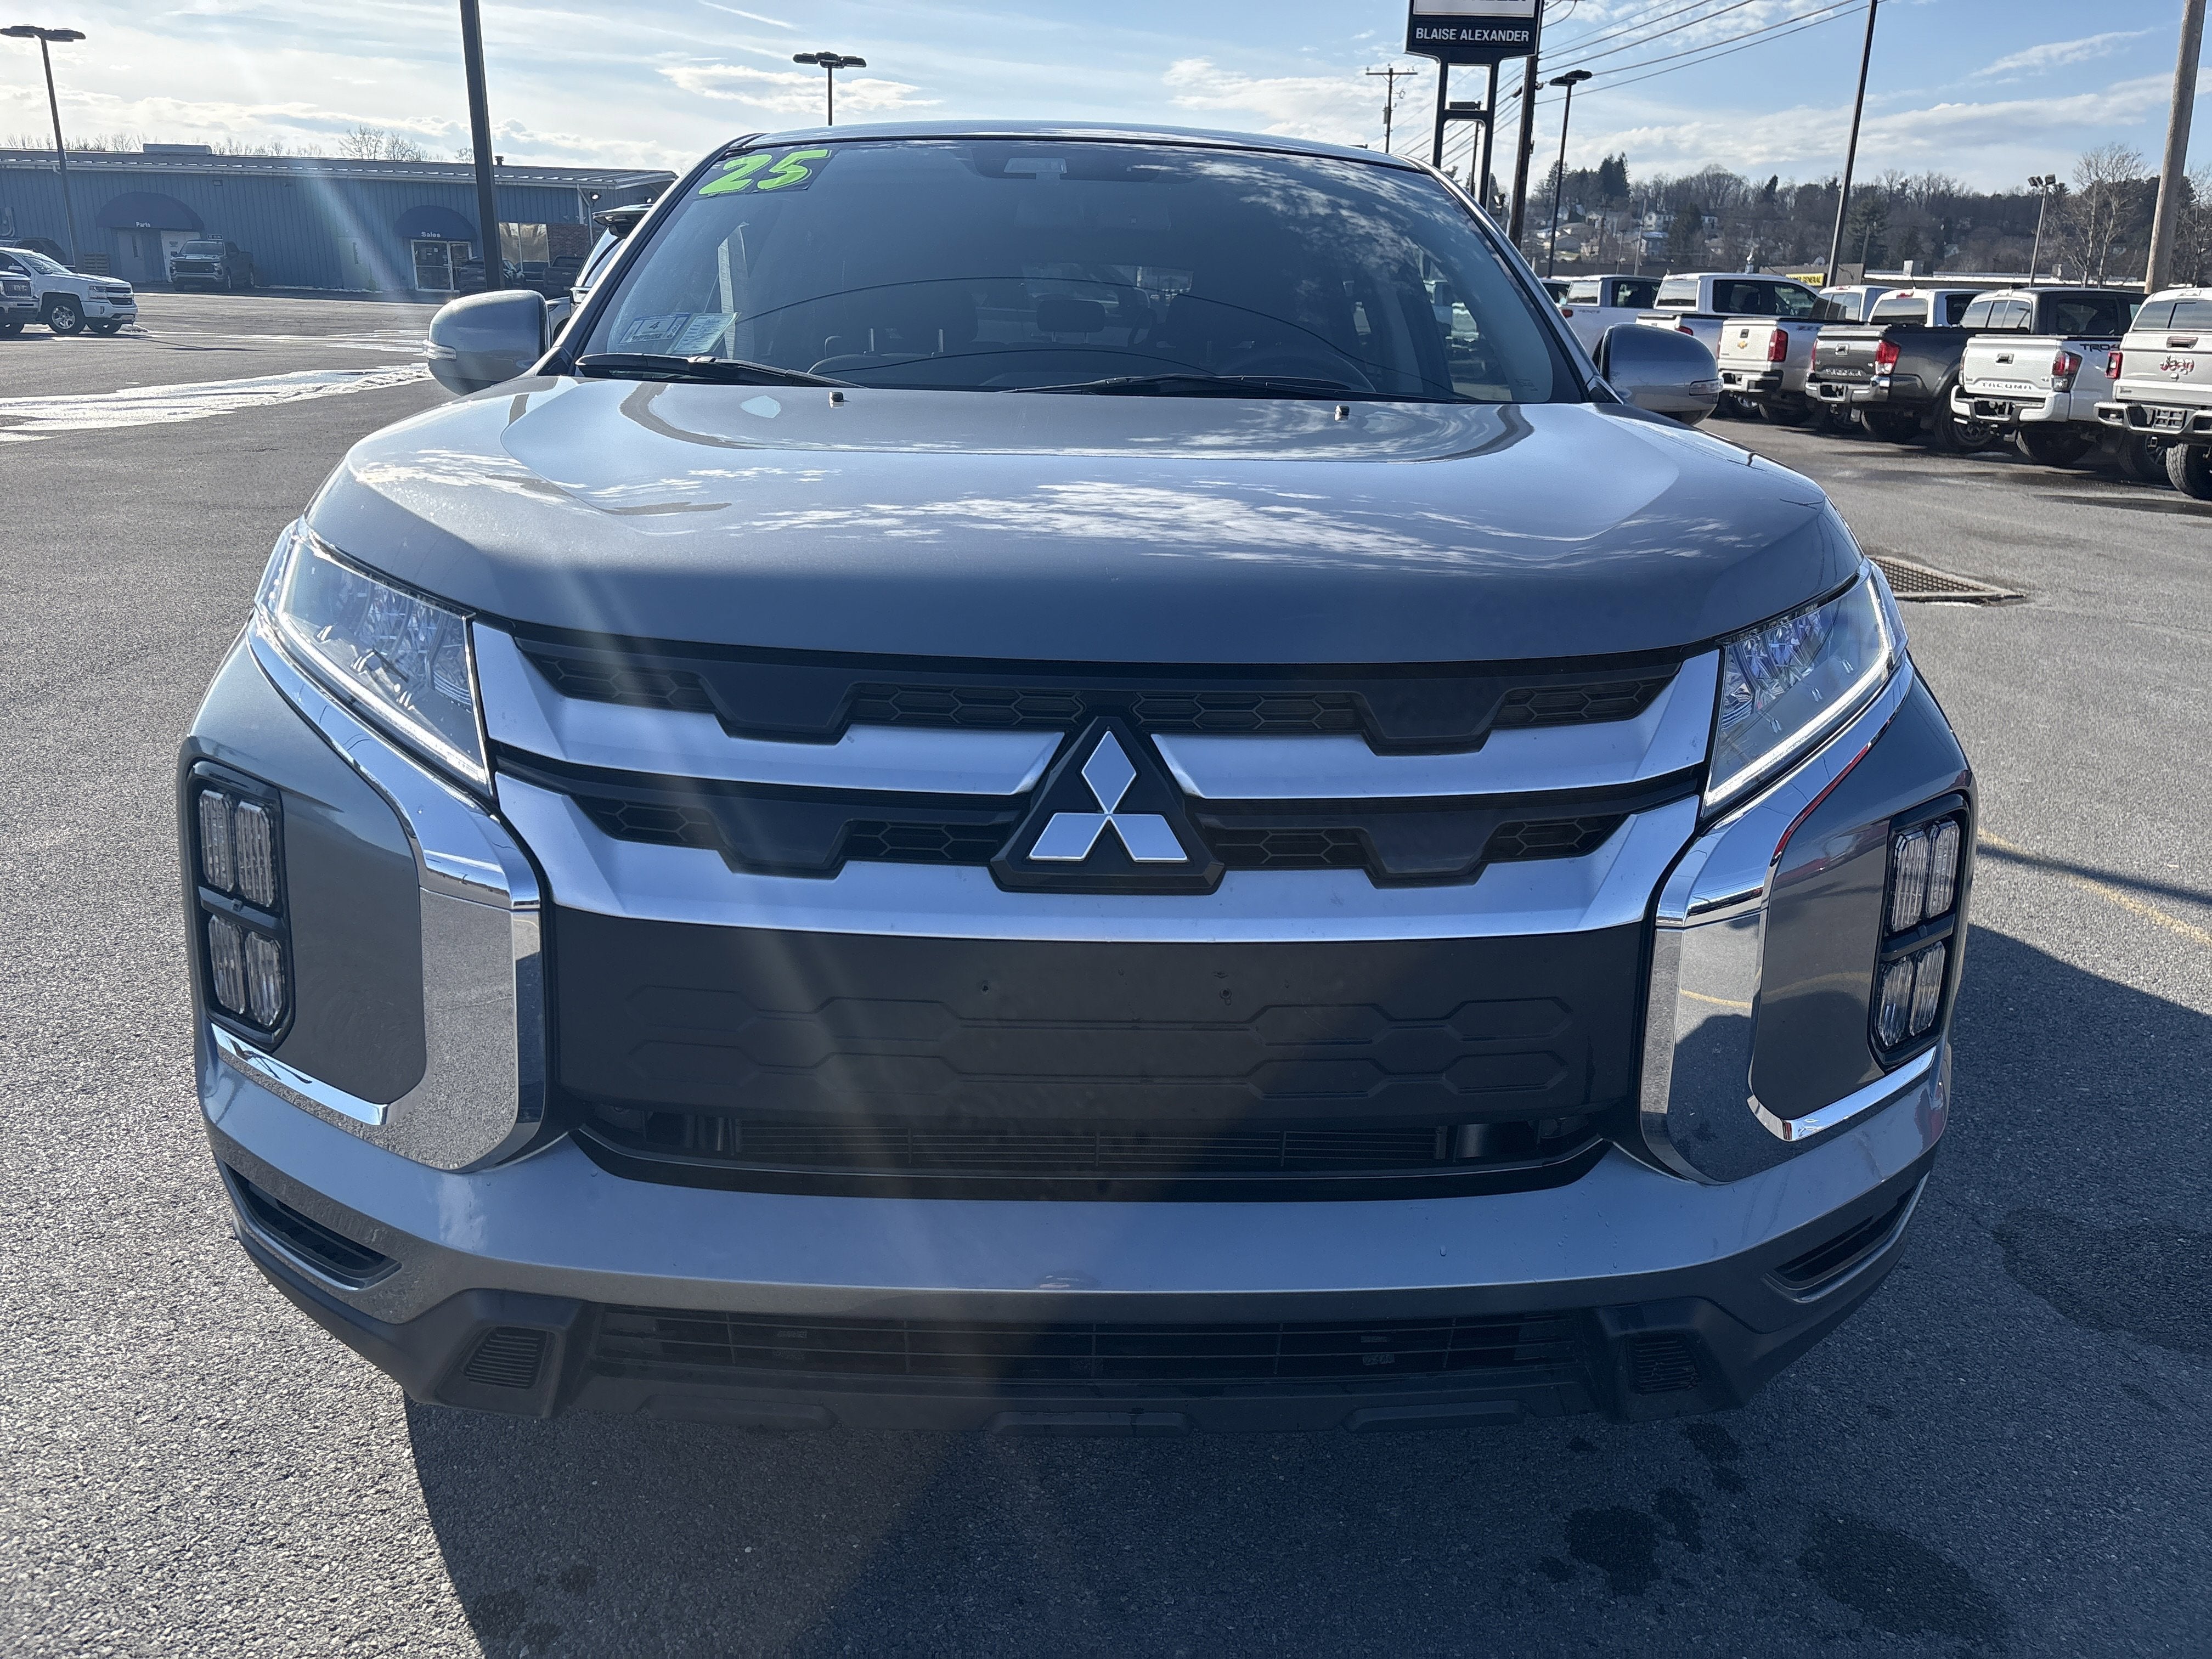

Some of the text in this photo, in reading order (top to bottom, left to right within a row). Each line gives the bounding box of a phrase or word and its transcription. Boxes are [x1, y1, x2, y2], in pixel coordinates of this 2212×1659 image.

[1415, 27, 1530, 42] BLAISE ALEXANDER
[698, 149, 831, 195] 25
[2079, 343, 2111, 352] TRD
[2159, 355, 2194, 375] Jeep
[1981, 382, 2032, 391] TACOMA
